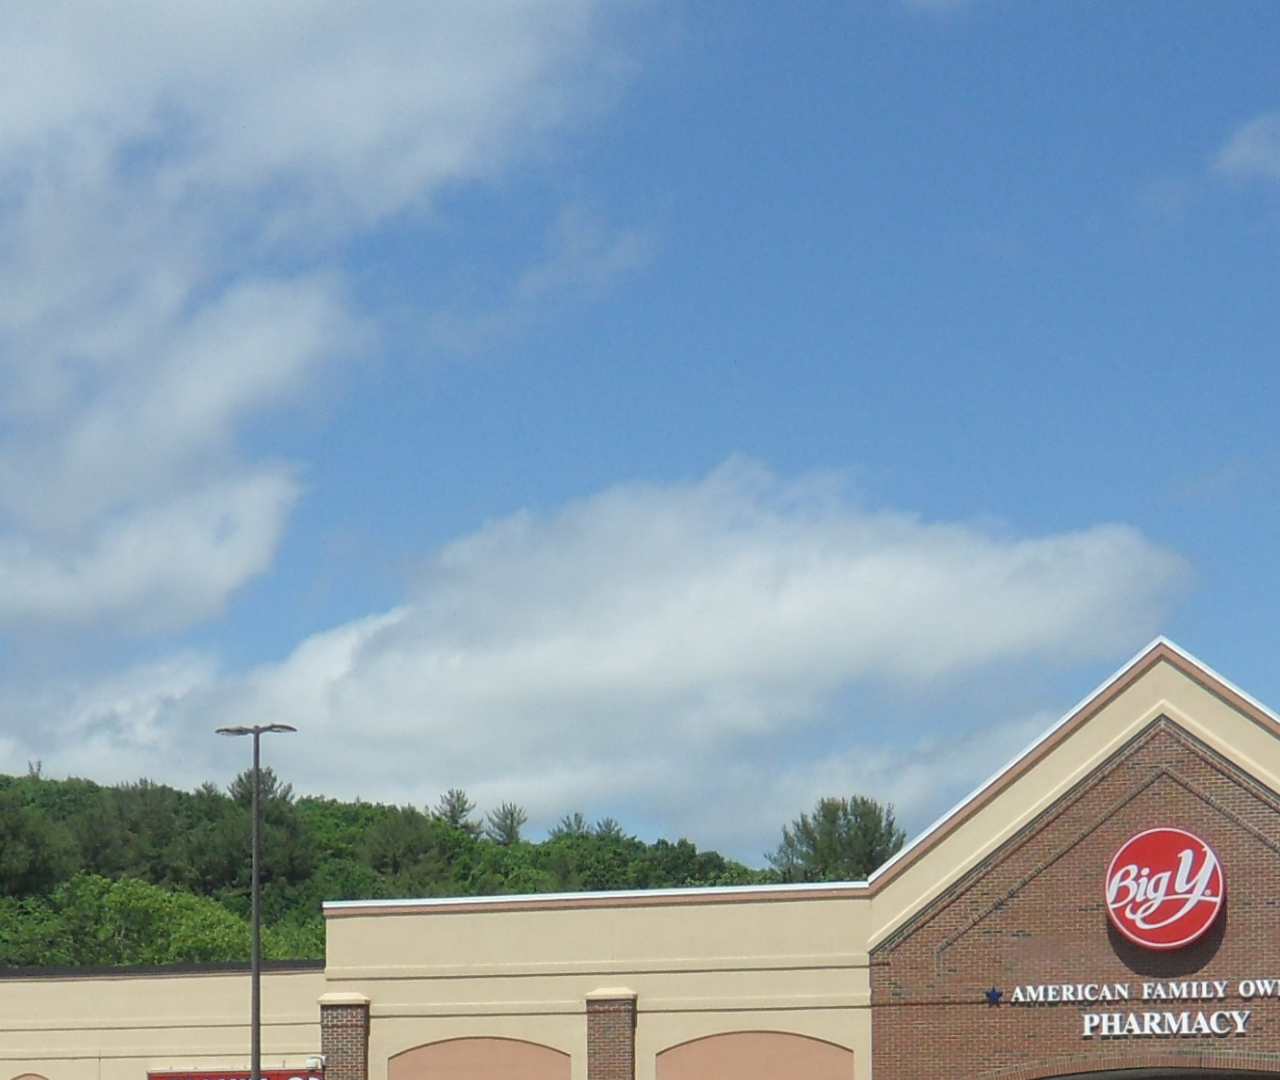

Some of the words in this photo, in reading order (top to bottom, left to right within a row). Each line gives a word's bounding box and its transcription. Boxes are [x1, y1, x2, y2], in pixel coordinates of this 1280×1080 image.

[1108, 864, 1172, 920] Big
[1011, 983, 1130, 1002] AMERICAN
[1142, 980, 1229, 1000] FAMILY
[1082, 1010, 1252, 1037] PHARMACY
